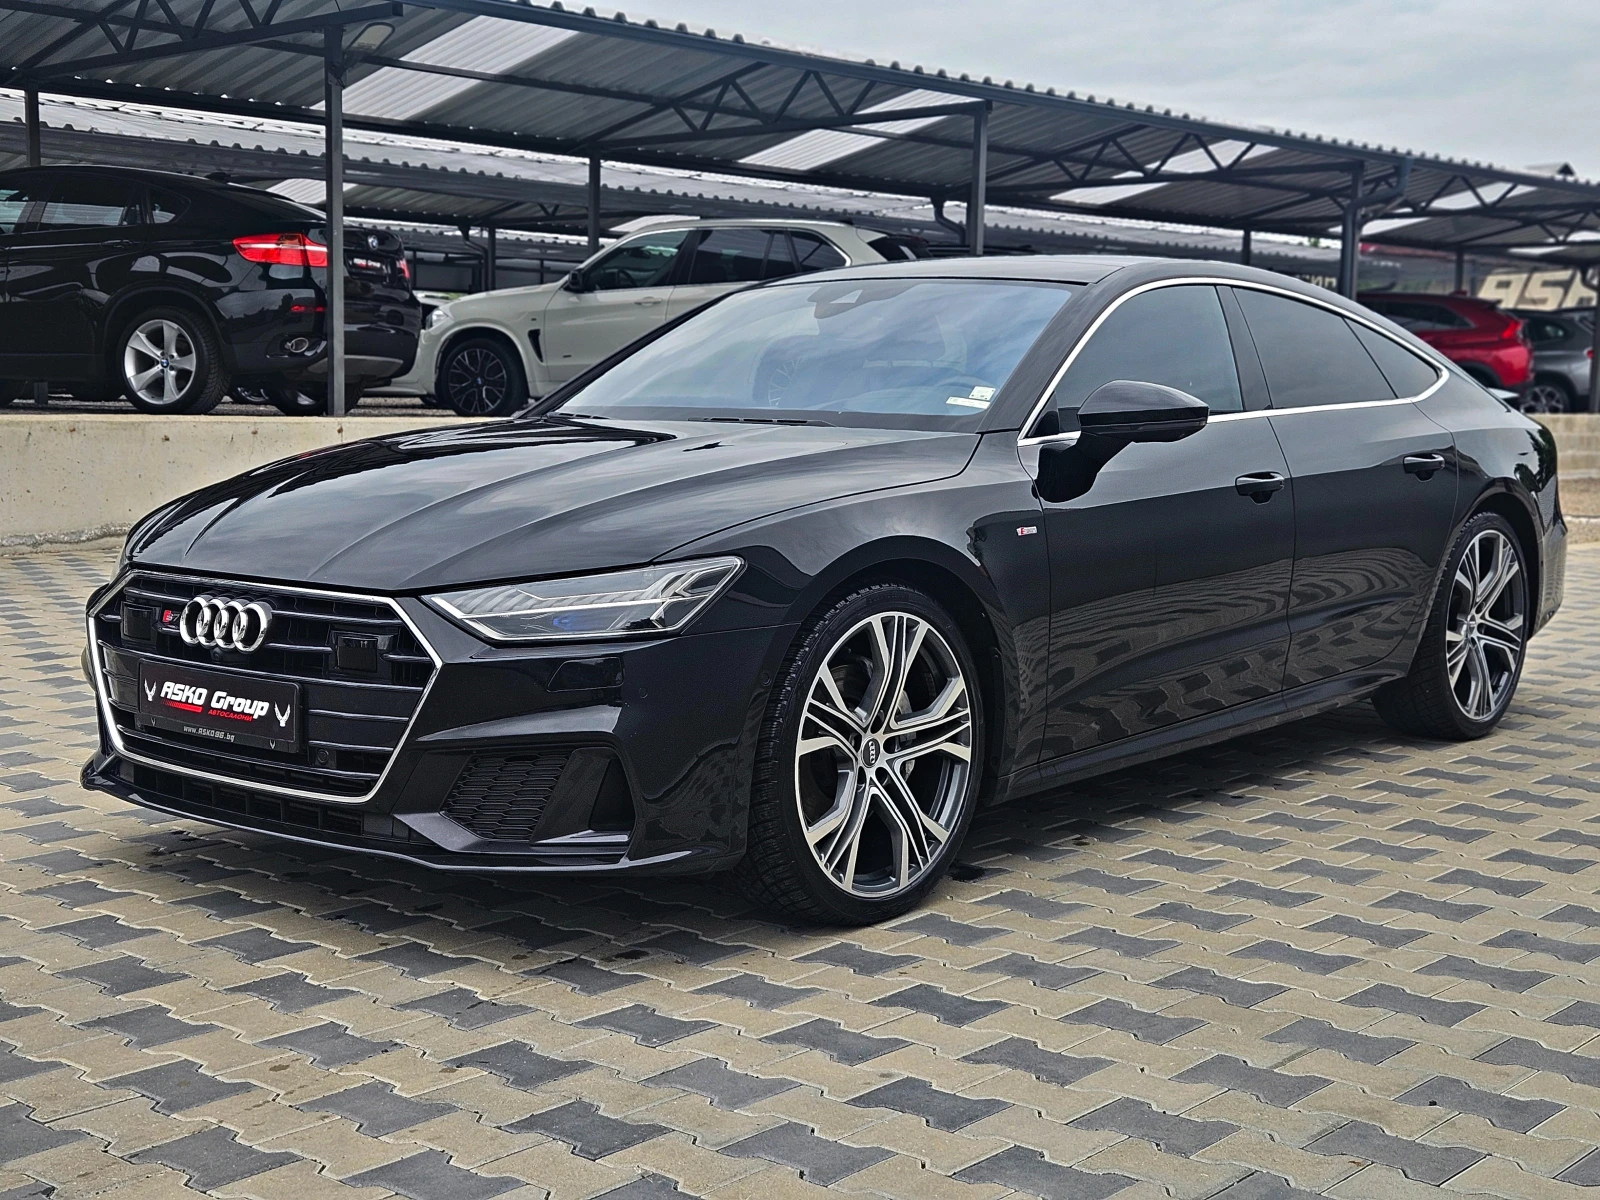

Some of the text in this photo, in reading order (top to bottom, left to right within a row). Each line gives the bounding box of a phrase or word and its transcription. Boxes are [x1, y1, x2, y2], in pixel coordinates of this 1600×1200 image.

[160, 681, 270, 719] ASKO Group
[208, 709, 253, 722] АВТОСАЛОНИ
